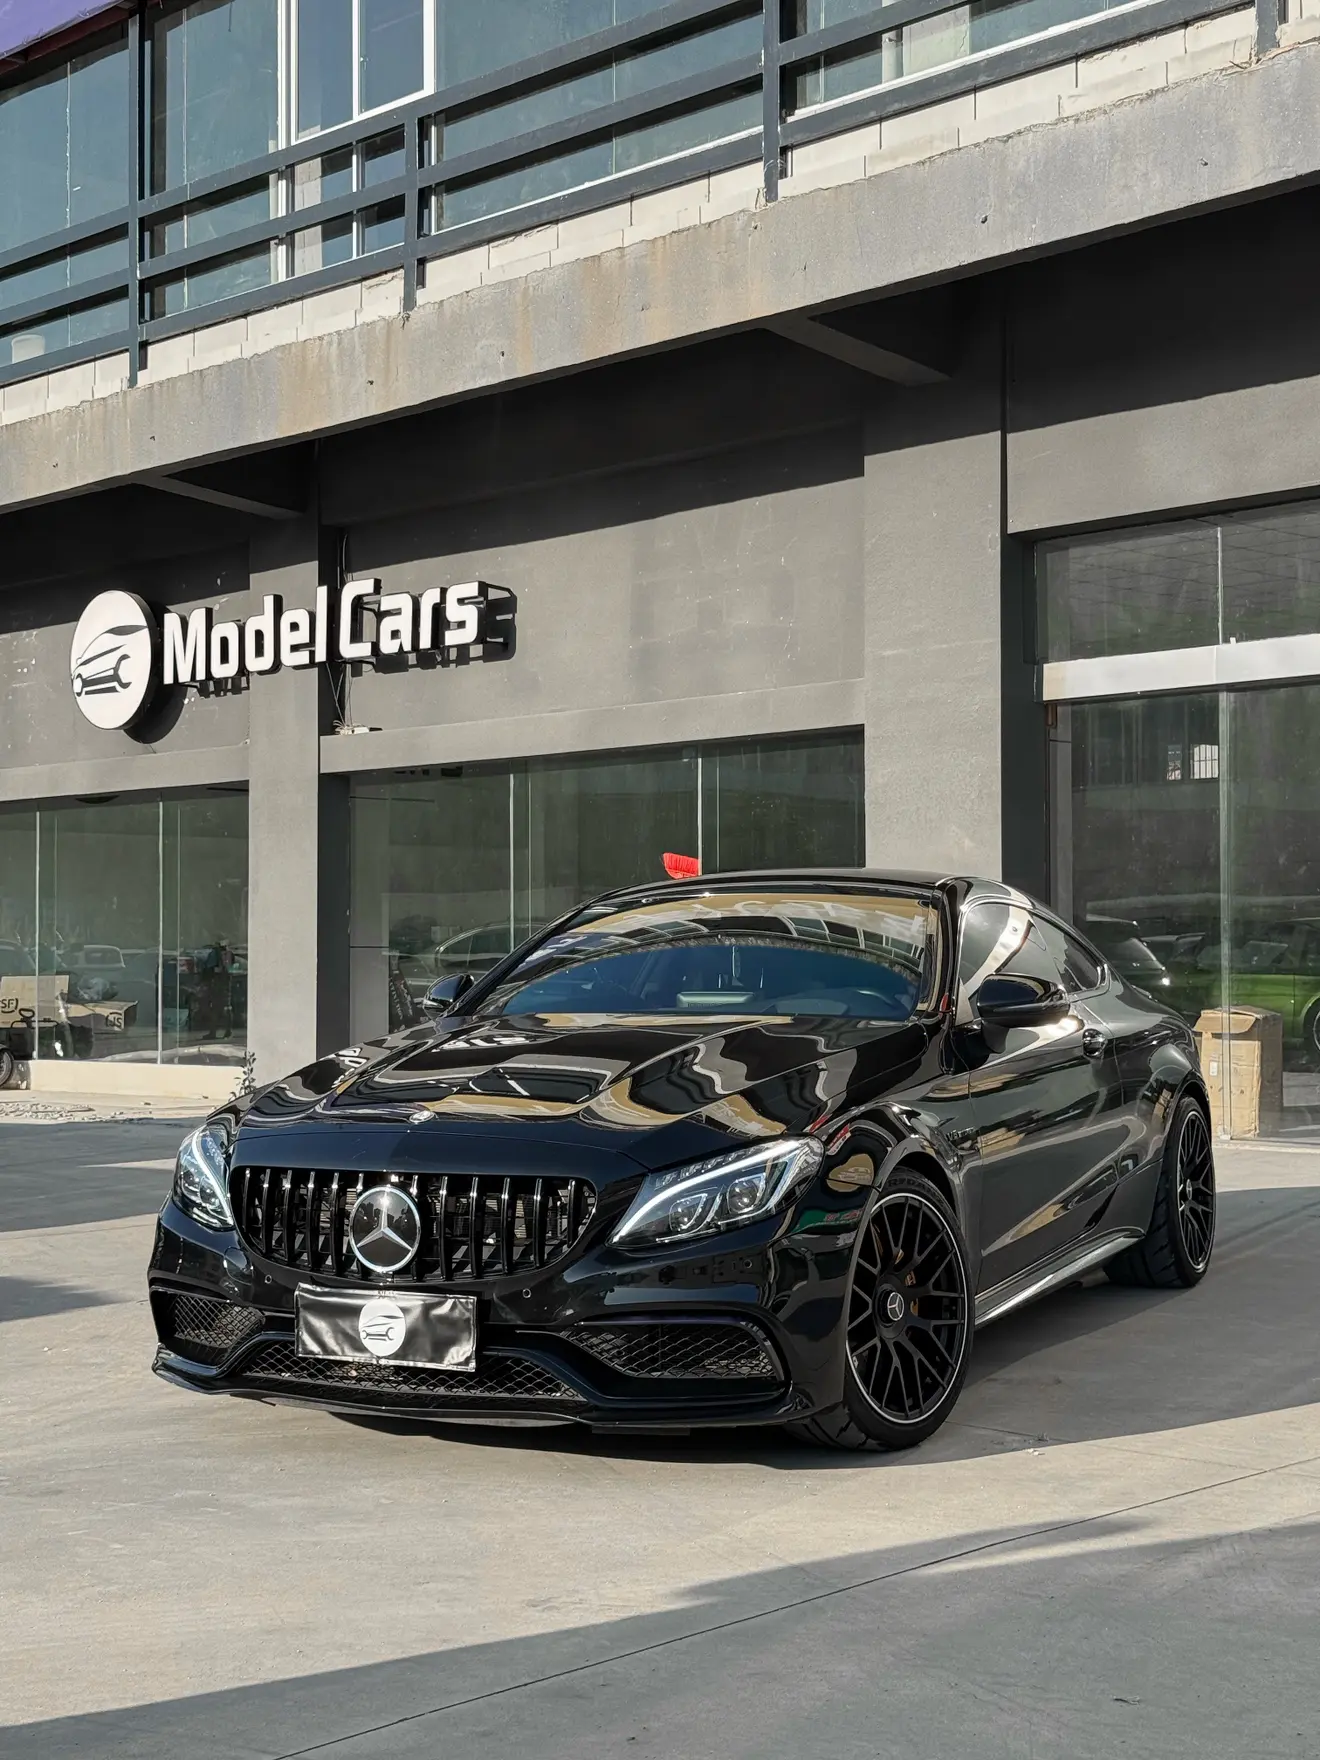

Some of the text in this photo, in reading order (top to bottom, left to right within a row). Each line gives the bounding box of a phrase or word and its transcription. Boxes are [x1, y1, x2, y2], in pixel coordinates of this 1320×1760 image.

[163, 578, 479, 685] Model Cars
[1, 998, 15, 1009] SF
